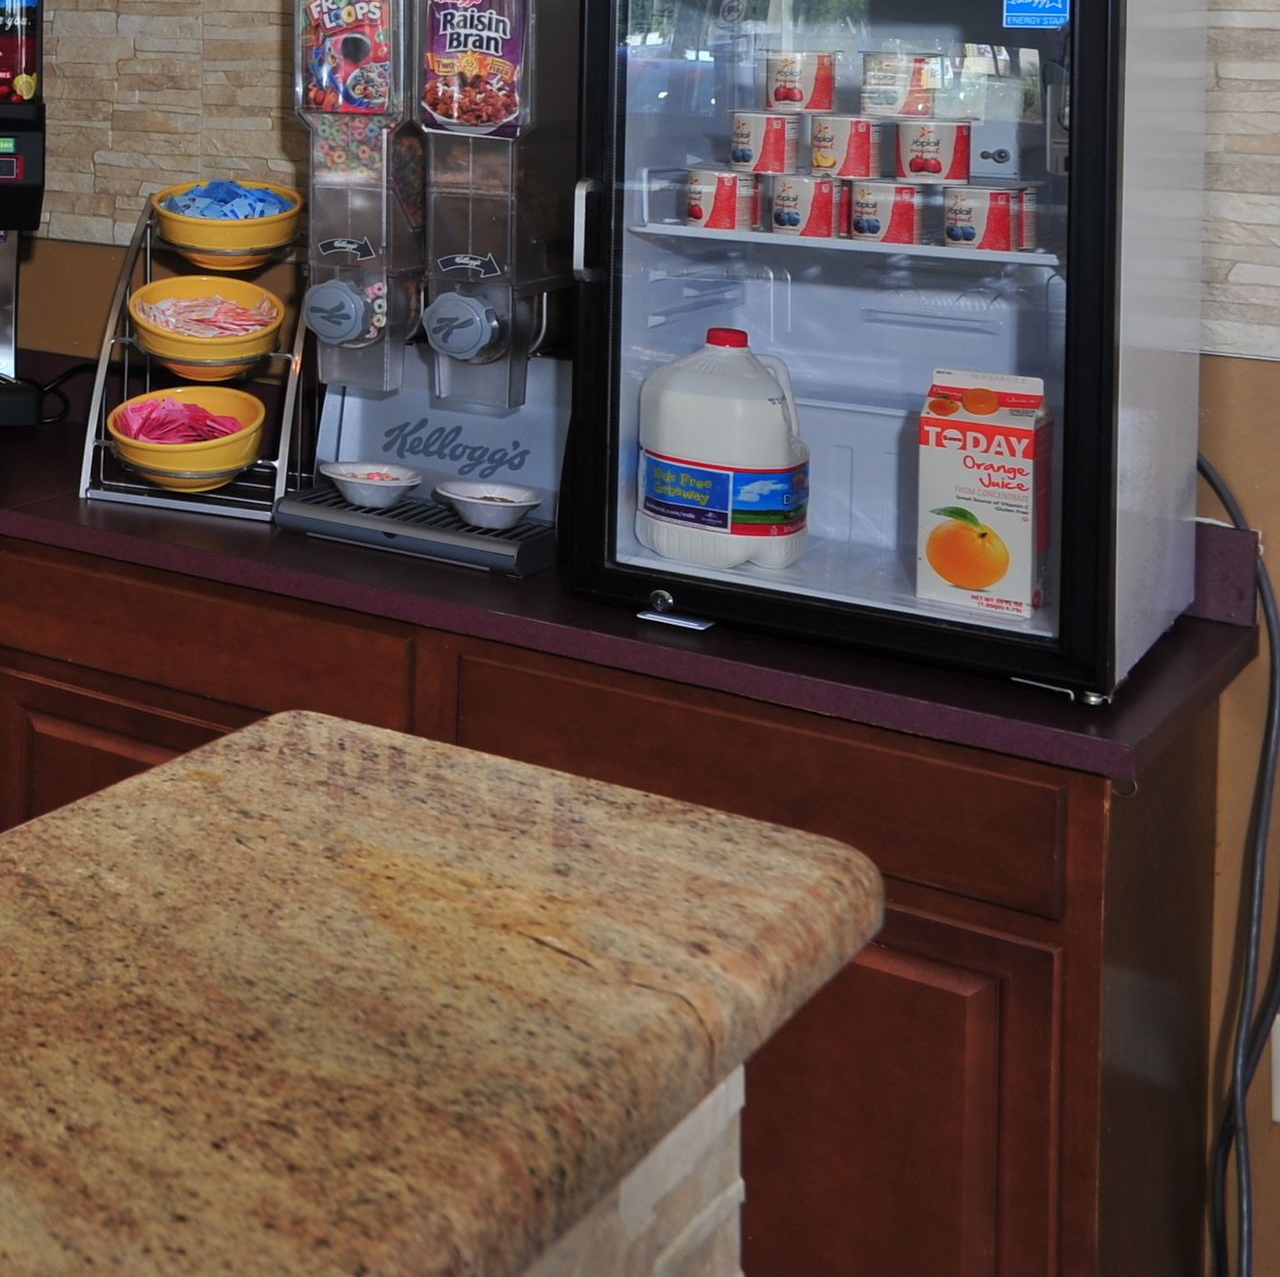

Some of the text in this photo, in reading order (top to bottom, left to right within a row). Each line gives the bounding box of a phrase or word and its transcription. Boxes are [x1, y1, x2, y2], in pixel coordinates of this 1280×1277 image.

[323, 1, 382, 29] LOOPS
[441, 9, 510, 38] Raisin
[1007, 16, 1041, 25] ENERGY
[446, 30, 502, 55] Bran
[383, 418, 530, 478] Kellogg's
[924, 425, 1030, 458] TODAY
[963, 455, 1030, 480] Orange
[954, 485, 976, 497] FROM
[979, 473, 1030, 492] Juice
